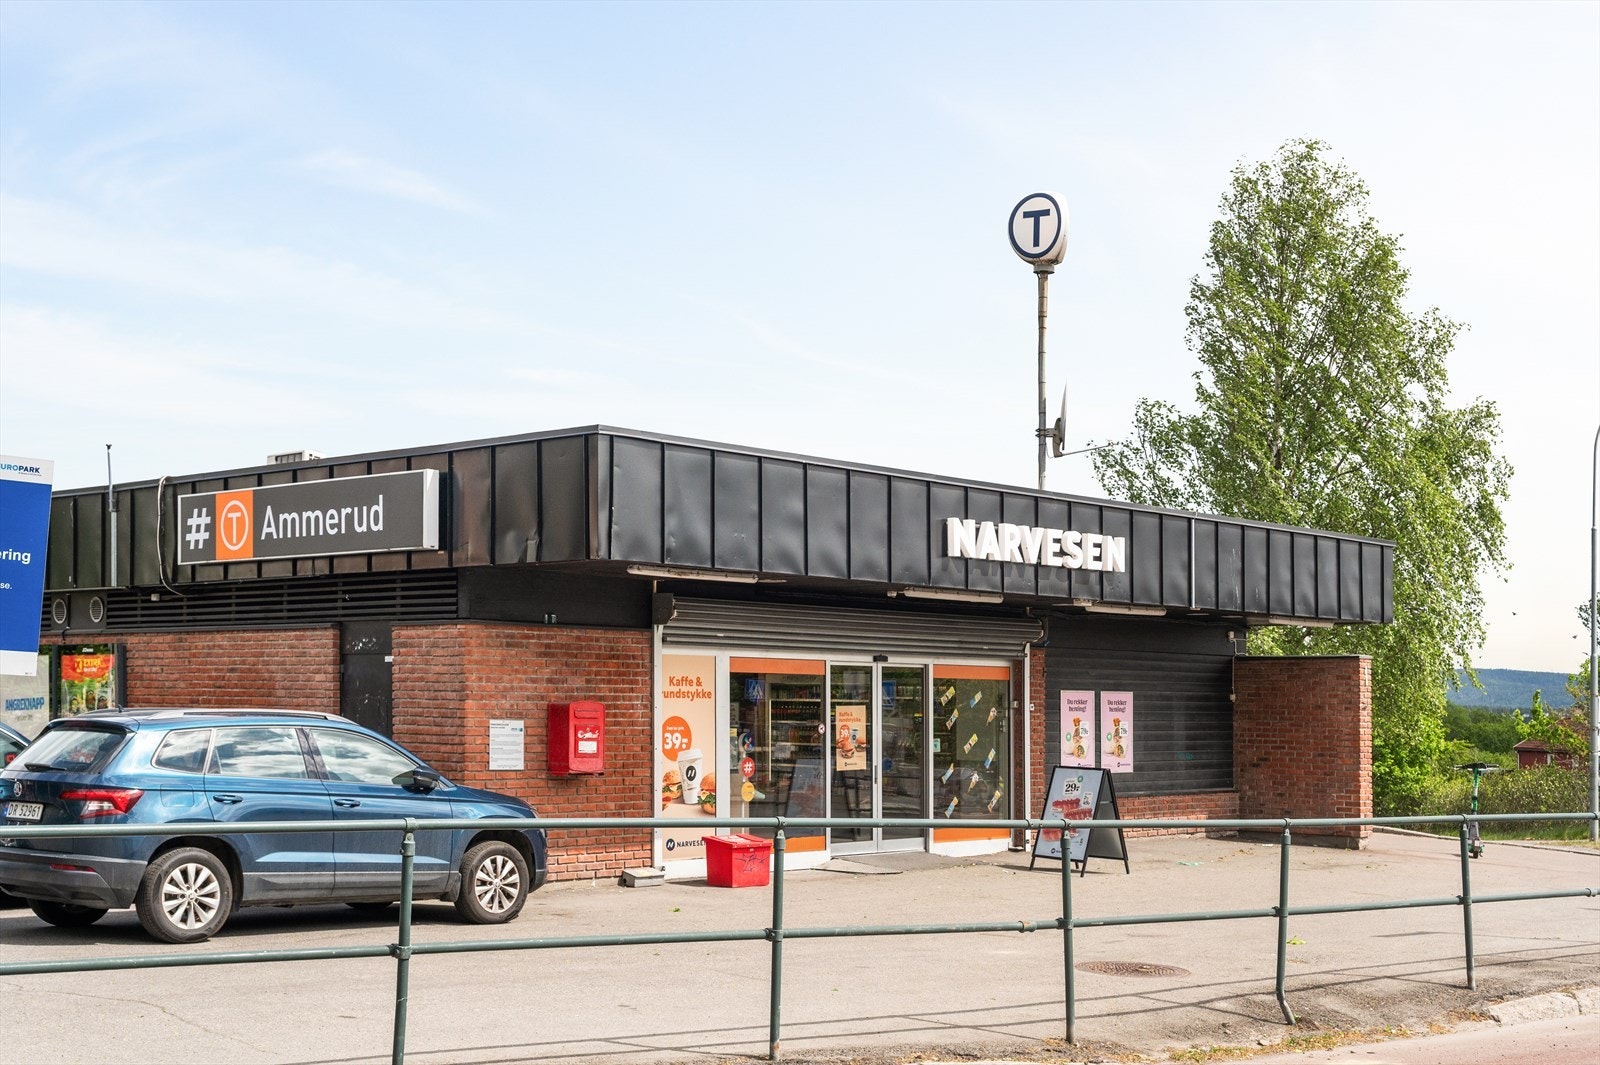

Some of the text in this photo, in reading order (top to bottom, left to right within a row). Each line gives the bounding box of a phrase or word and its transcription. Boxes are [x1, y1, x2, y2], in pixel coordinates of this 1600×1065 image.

[1023, 208, 1050, 247] T
[261, 494, 384, 541] Ammerud
[946, 517, 1125, 573] NARVESEN
[669, 676, 703, 687] Kaffe &
[8, 801, 40, 819] DR 52961
